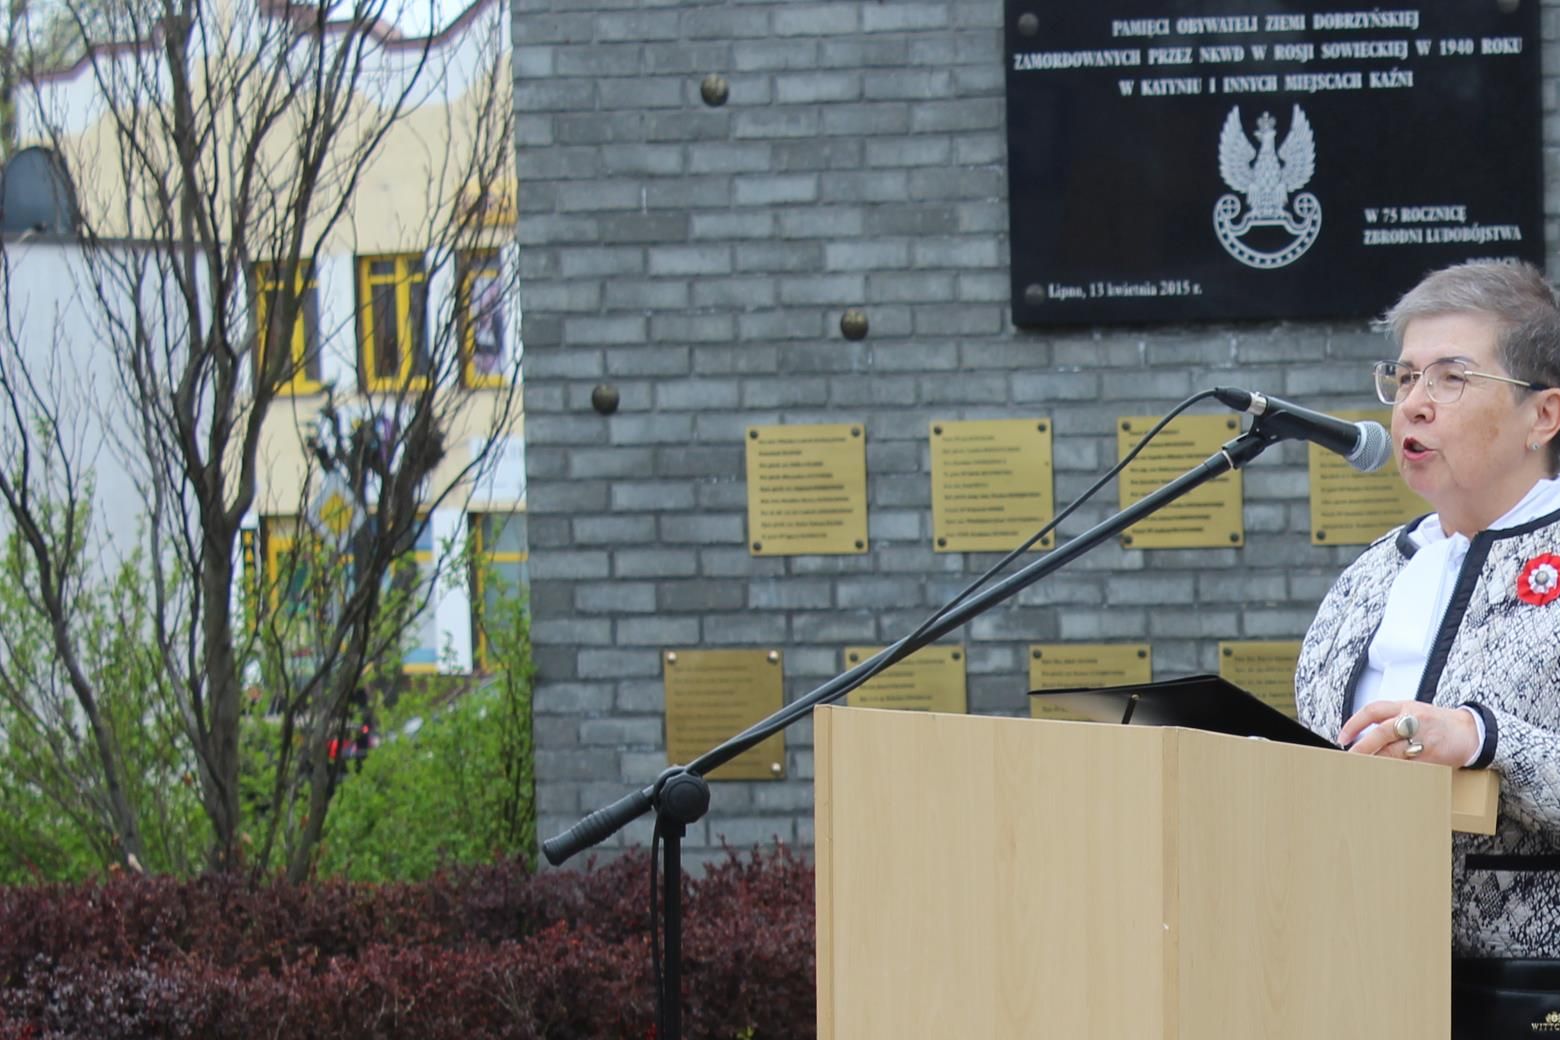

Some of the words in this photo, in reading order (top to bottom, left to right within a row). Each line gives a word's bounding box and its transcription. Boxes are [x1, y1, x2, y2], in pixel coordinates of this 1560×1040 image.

[1112, 19, 1170, 38] PAMIĘCI
[1176, 16, 1258, 34] OBYWATELI
[1265, 14, 1306, 32] ZIEMI
[1313, 8, 1420, 30] DOBRZYŃSKIEJ
[1014, 49, 1141, 70] ZAMORDOWANYCH
[1148, 47, 1193, 66] PRZEZ
[1199, 45, 1245, 63] NKWD
[1251, 44, 1268, 61] W
[1274, 43, 1315, 63] ROSJI
[1321, 40, 1408, 60] SOWIECKIEJ
[1415, 39, 1432, 56] W
[1439, 38, 1475, 56] 1940
[1481, 37, 1523, 55] ROKU
[1118, 79, 1134, 96] W
[1140, 77, 1202, 96] KATYNIU
[1209, 77, 1217, 93] I
[1223, 75, 1278, 93] INNYCH
[1285, 72, 1363, 93] MIEJSCACH
[1369, 67, 1414, 88] KAŹNI
[1364, 208, 1379, 223] W
[1382, 207, 1398, 223] 75
[1401, 205, 1467, 223] ROCZNICĘ
[1363, 228, 1423, 245] ZBRODNI
[1426, 222, 1522, 244] LUDOBÓJSTWA
[1048, 283, 1086, 300] Lipno,
[1089, 282, 1104, 297] 13
[1107, 281, 1157, 296] kwietnia
[1160, 280, 1190, 296] 2015
